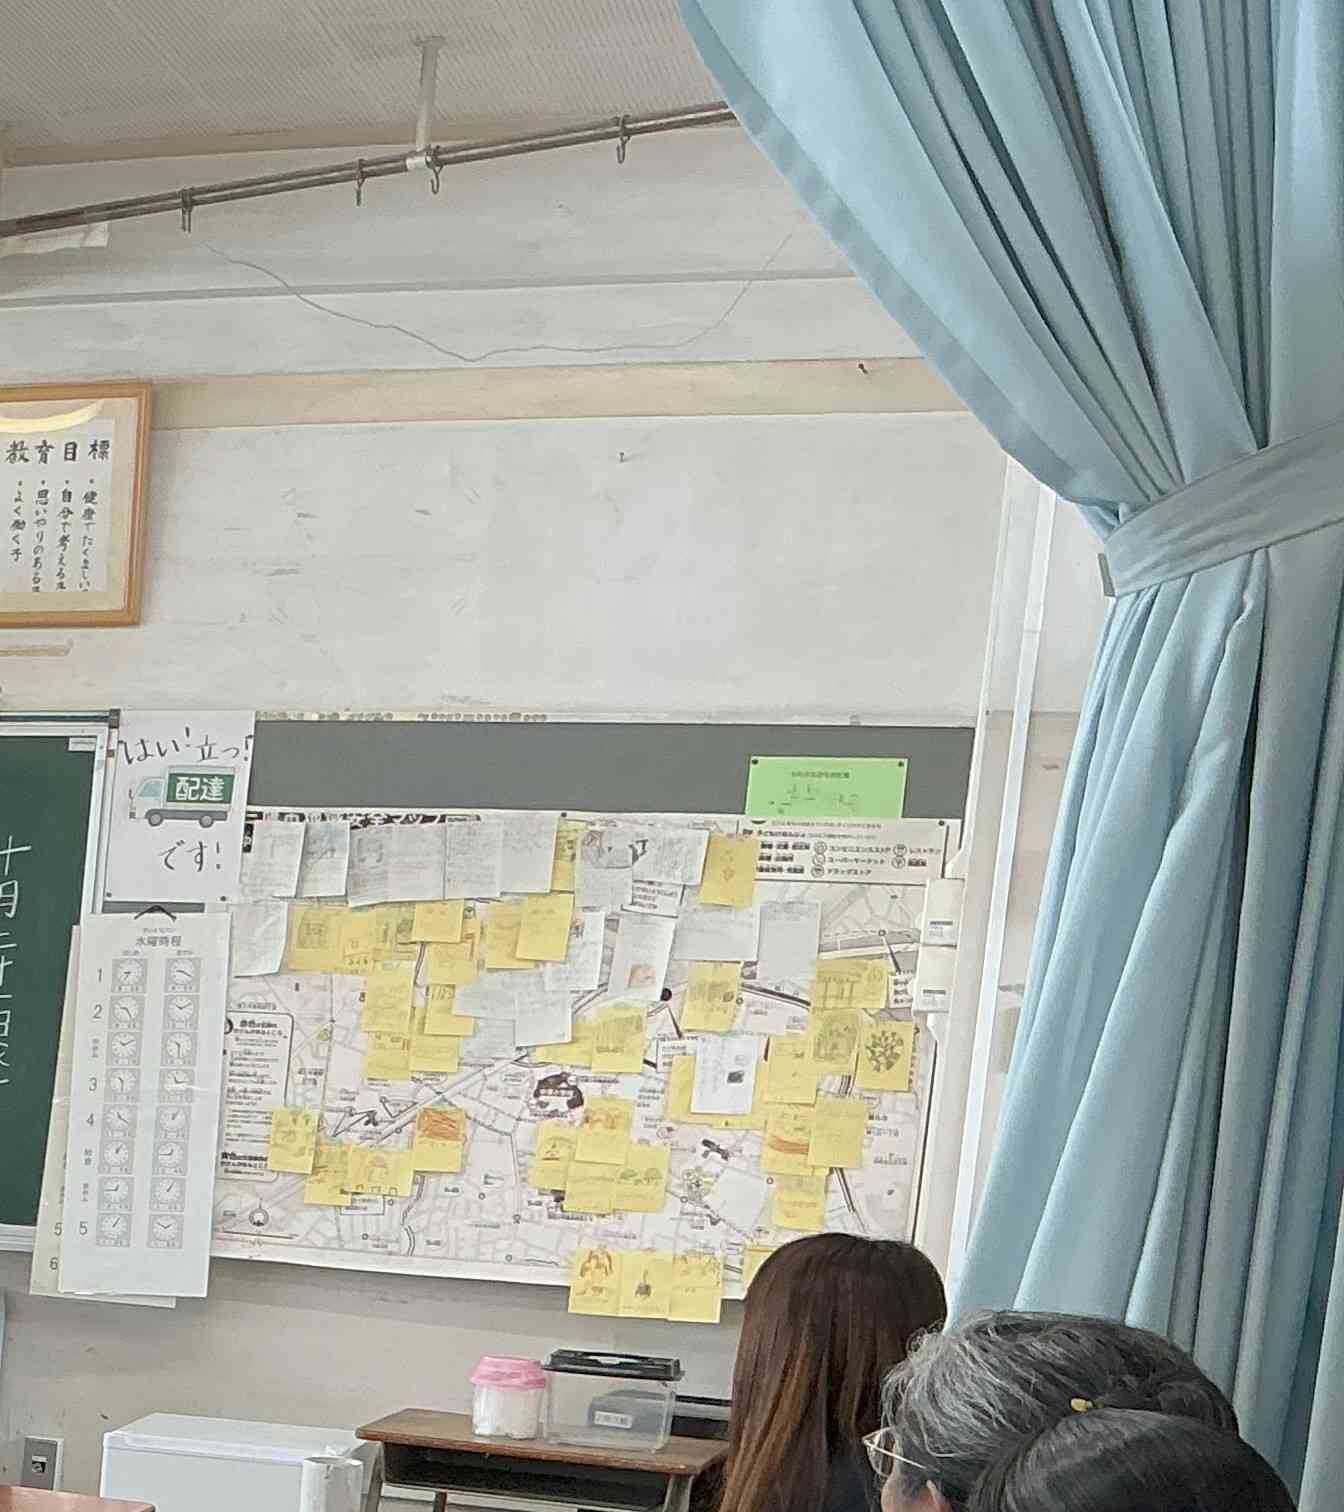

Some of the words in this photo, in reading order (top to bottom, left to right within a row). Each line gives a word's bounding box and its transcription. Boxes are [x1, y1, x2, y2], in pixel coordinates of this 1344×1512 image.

[4, 439, 110, 465] 教育目標
[175, 776, 226, 801] 配達
[160, 840, 222, 872] です!
[96, 967, 103, 984] 1
[93, 1004, 103, 1020] 2
[88, 1076, 98, 1092] 3
[85, 1113, 95, 1127] 4
[54, 1222, 63, 1237] 5
[78, 1220, 89, 1236] 5
[49, 1256, 58, 1271] 6
